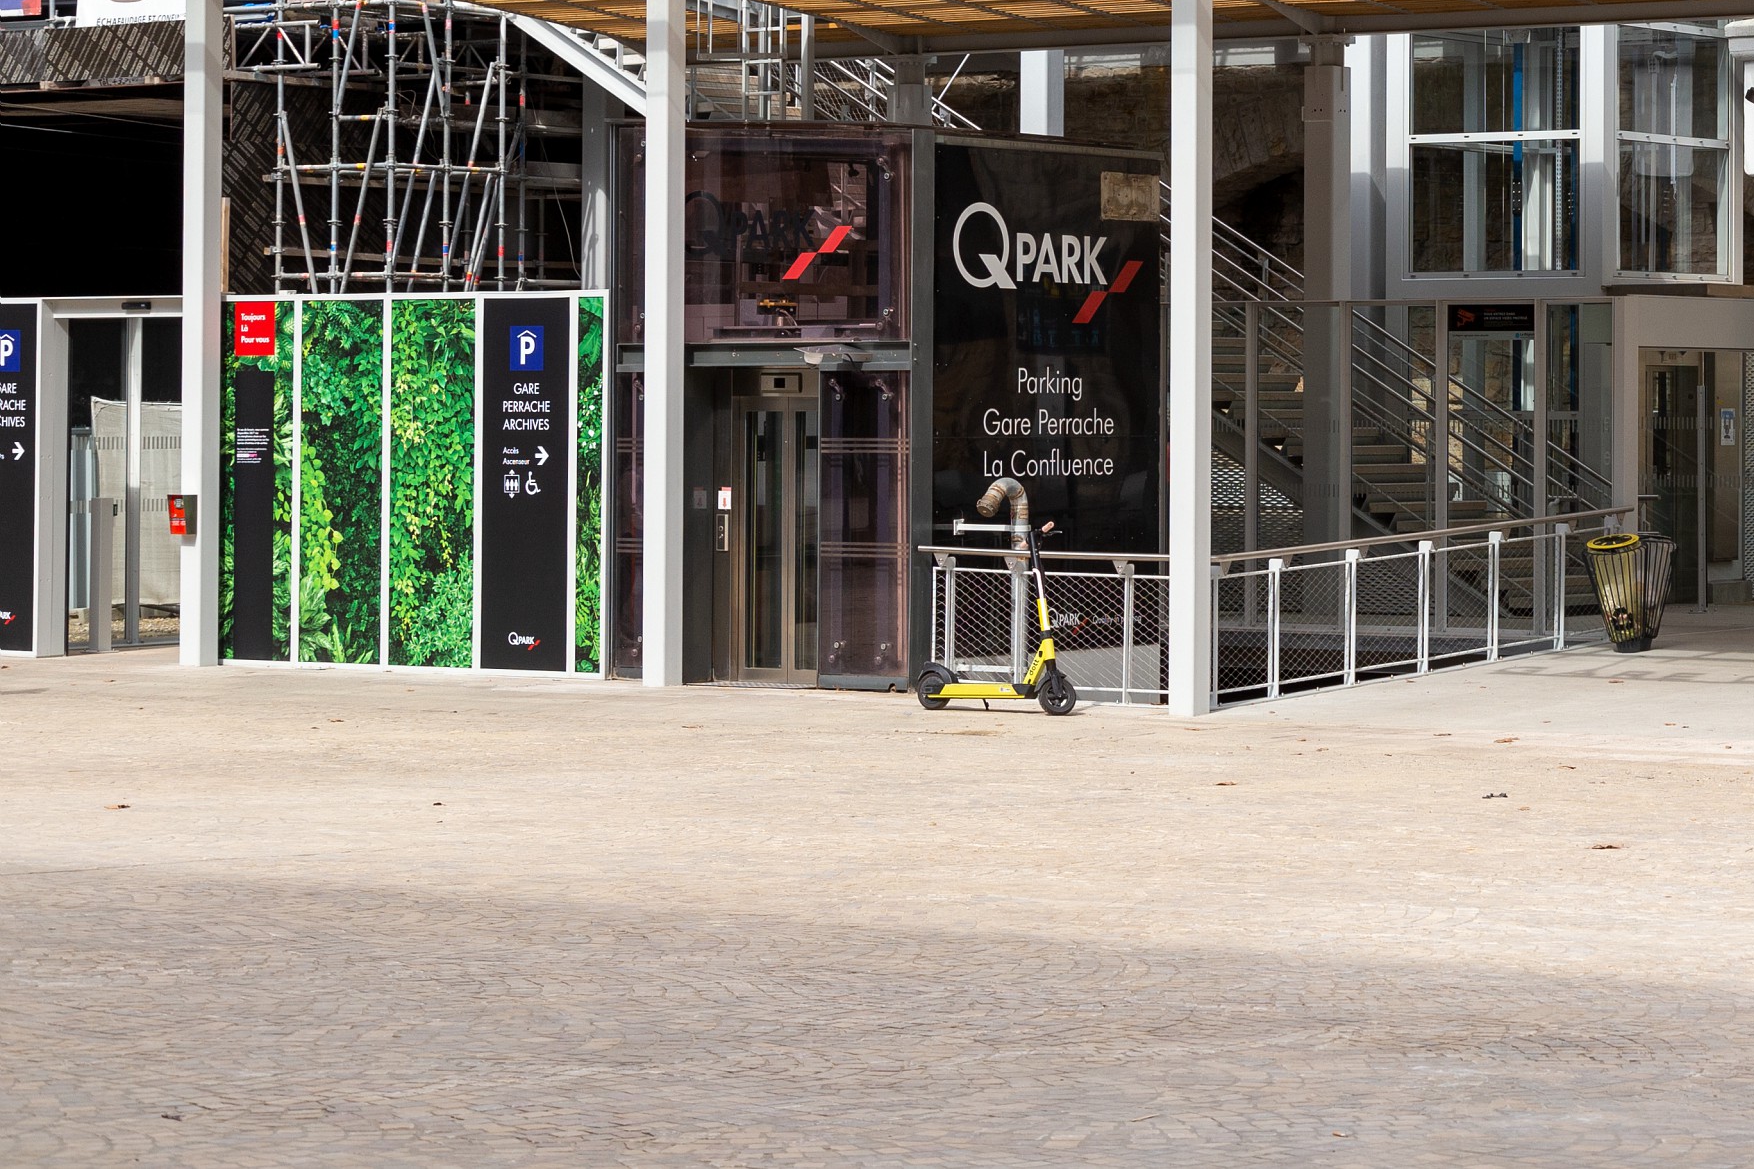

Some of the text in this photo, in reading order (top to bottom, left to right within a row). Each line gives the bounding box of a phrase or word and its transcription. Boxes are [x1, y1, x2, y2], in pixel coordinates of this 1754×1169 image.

[240, 313, 266, 323] Toujours
[240, 324, 248, 332] Là
[240, 336, 254, 344] Pour
[513, 383, 540, 395] GARE
[1018, 368, 1083, 400] Parking
[502, 400, 551, 413] PERRACHE
[502, 418, 550, 430] ARCHIVES
[983, 408, 1115, 436] Gare Perrache
[502, 447, 519, 455] Accès
[983, 450, 1114, 477] La Confluence
